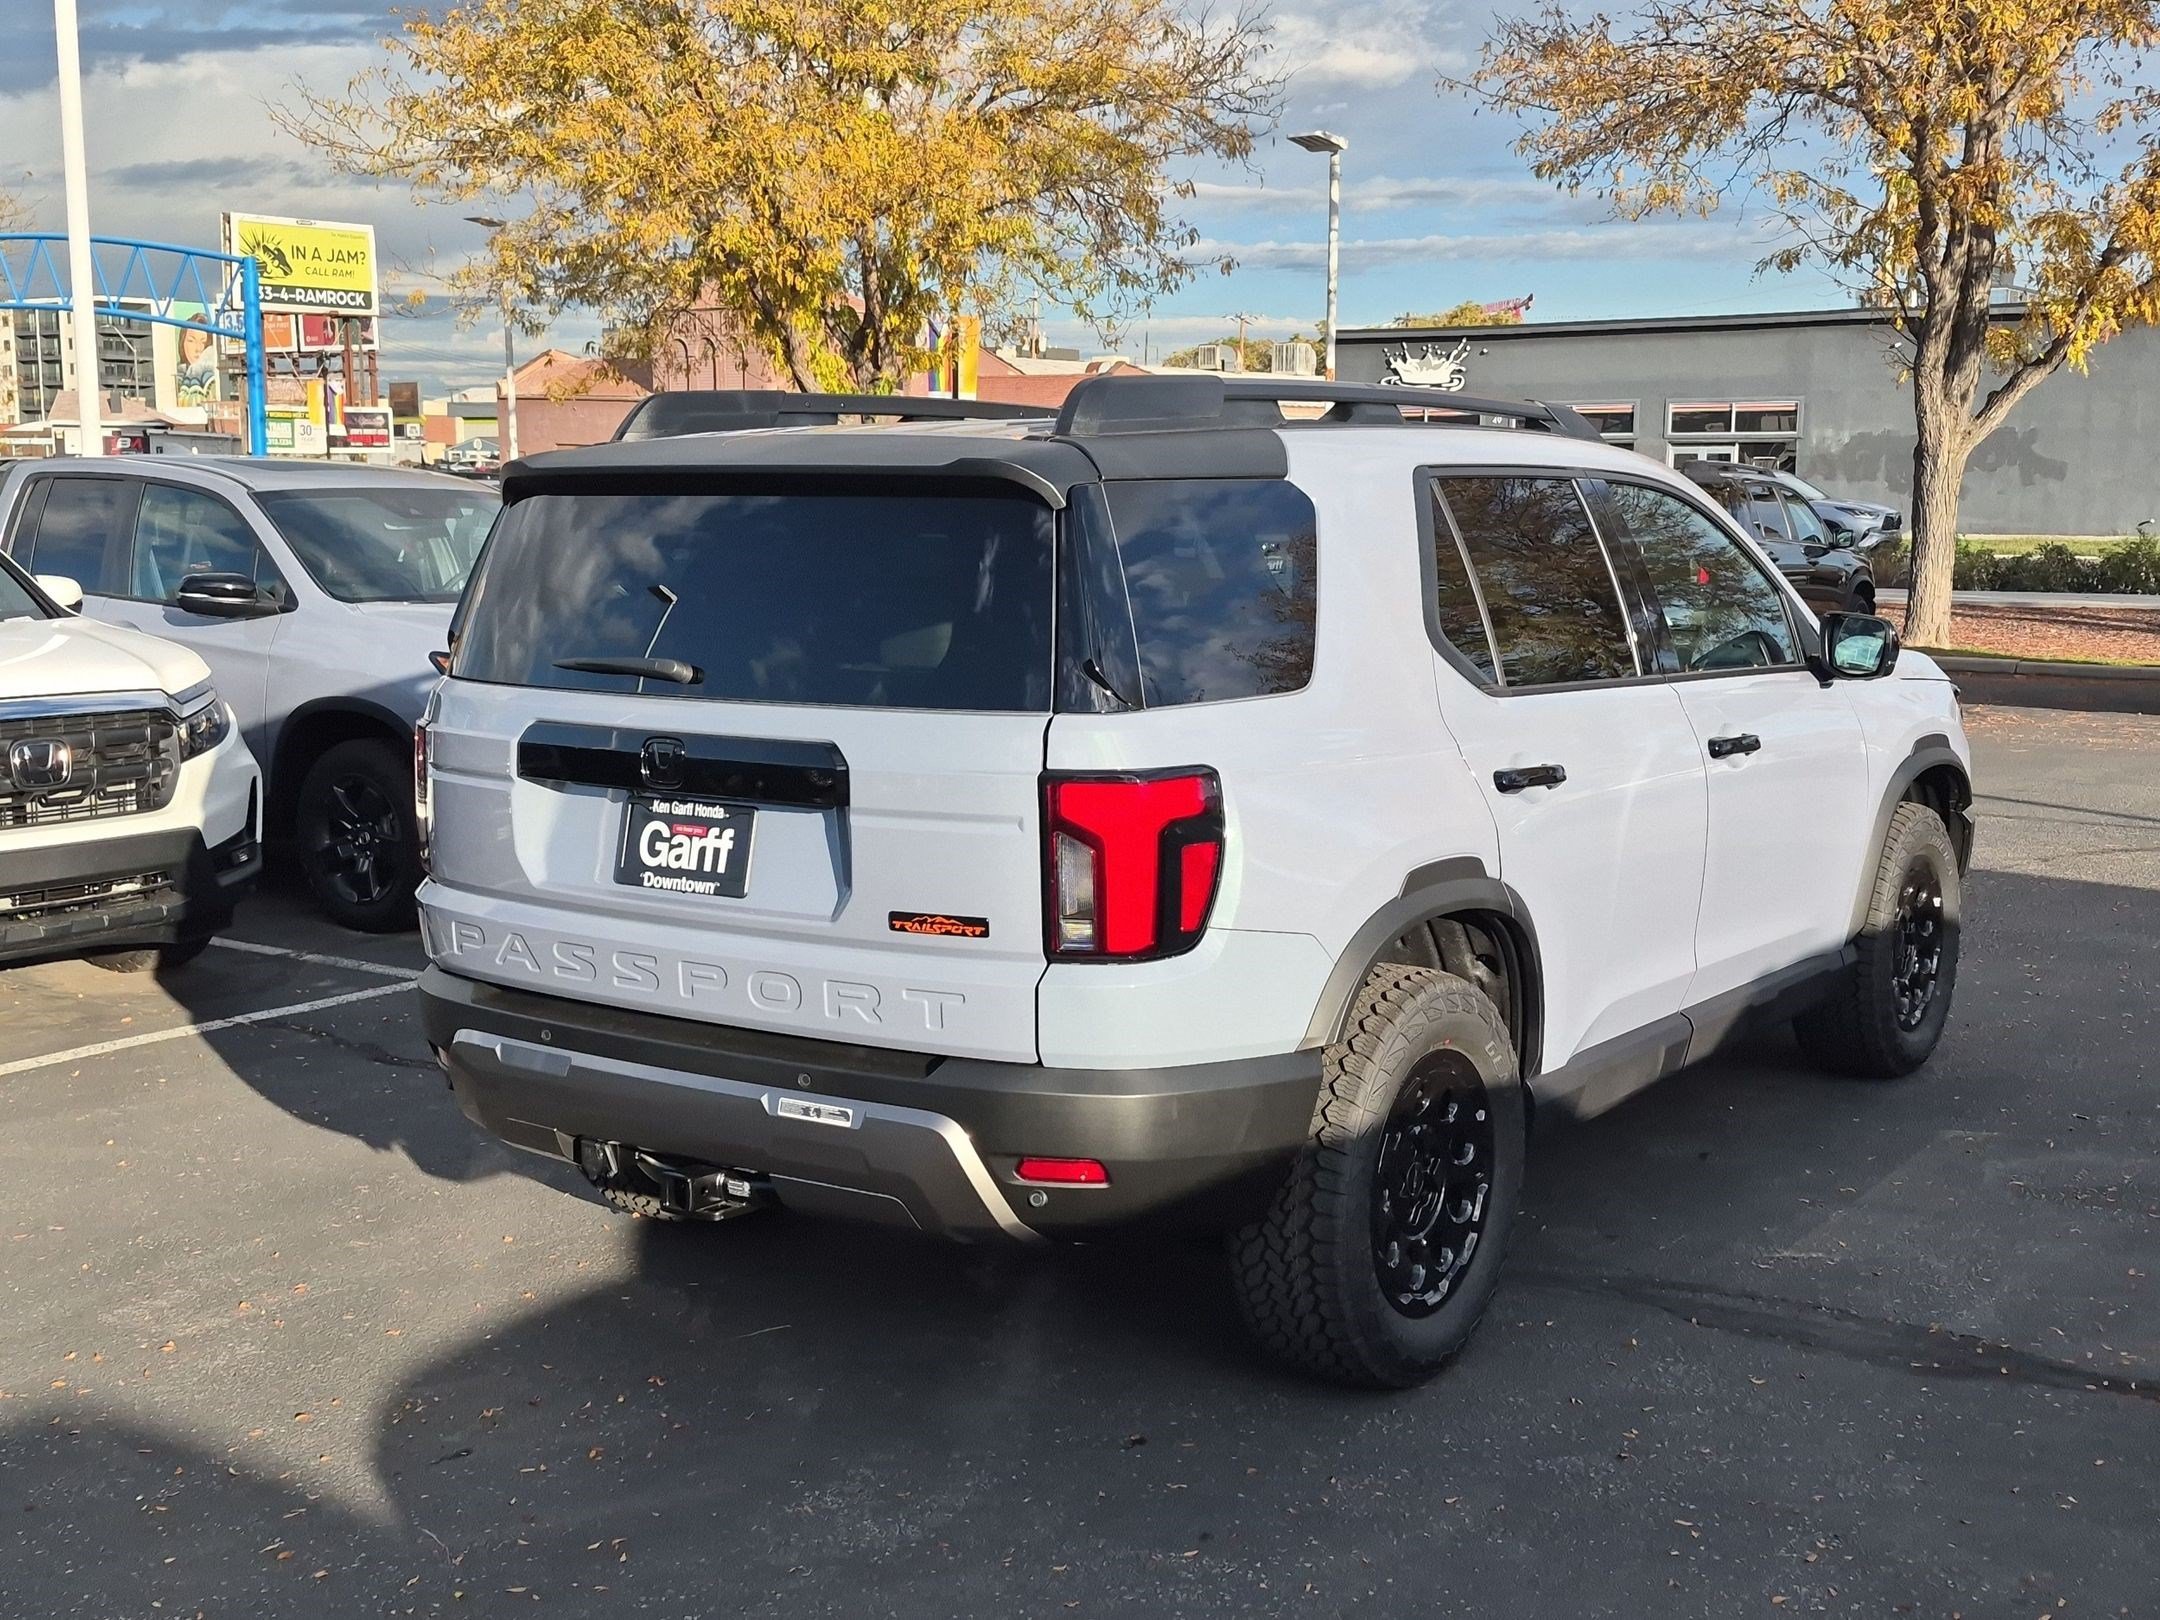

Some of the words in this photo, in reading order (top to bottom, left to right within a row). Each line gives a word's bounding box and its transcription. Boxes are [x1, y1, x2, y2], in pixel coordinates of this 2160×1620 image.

[291, 245, 306, 260] IN
[312, 249, 322, 261] A
[326, 250, 366, 265] JAM?
[305, 267, 329, 277] CALL
[332, 269, 355, 278] RAM!
[299, 425, 312, 436] 30
[653, 799, 670, 814] Ken
[671, 801, 694, 816] Garff
[694, 803, 725, 819] Honda
[639, 820, 735, 874] Garff
[643, 872, 715, 895] Downtown
[892, 920, 986, 936] TRAILSPORT
[451, 919, 967, 1030] PASSPORT
